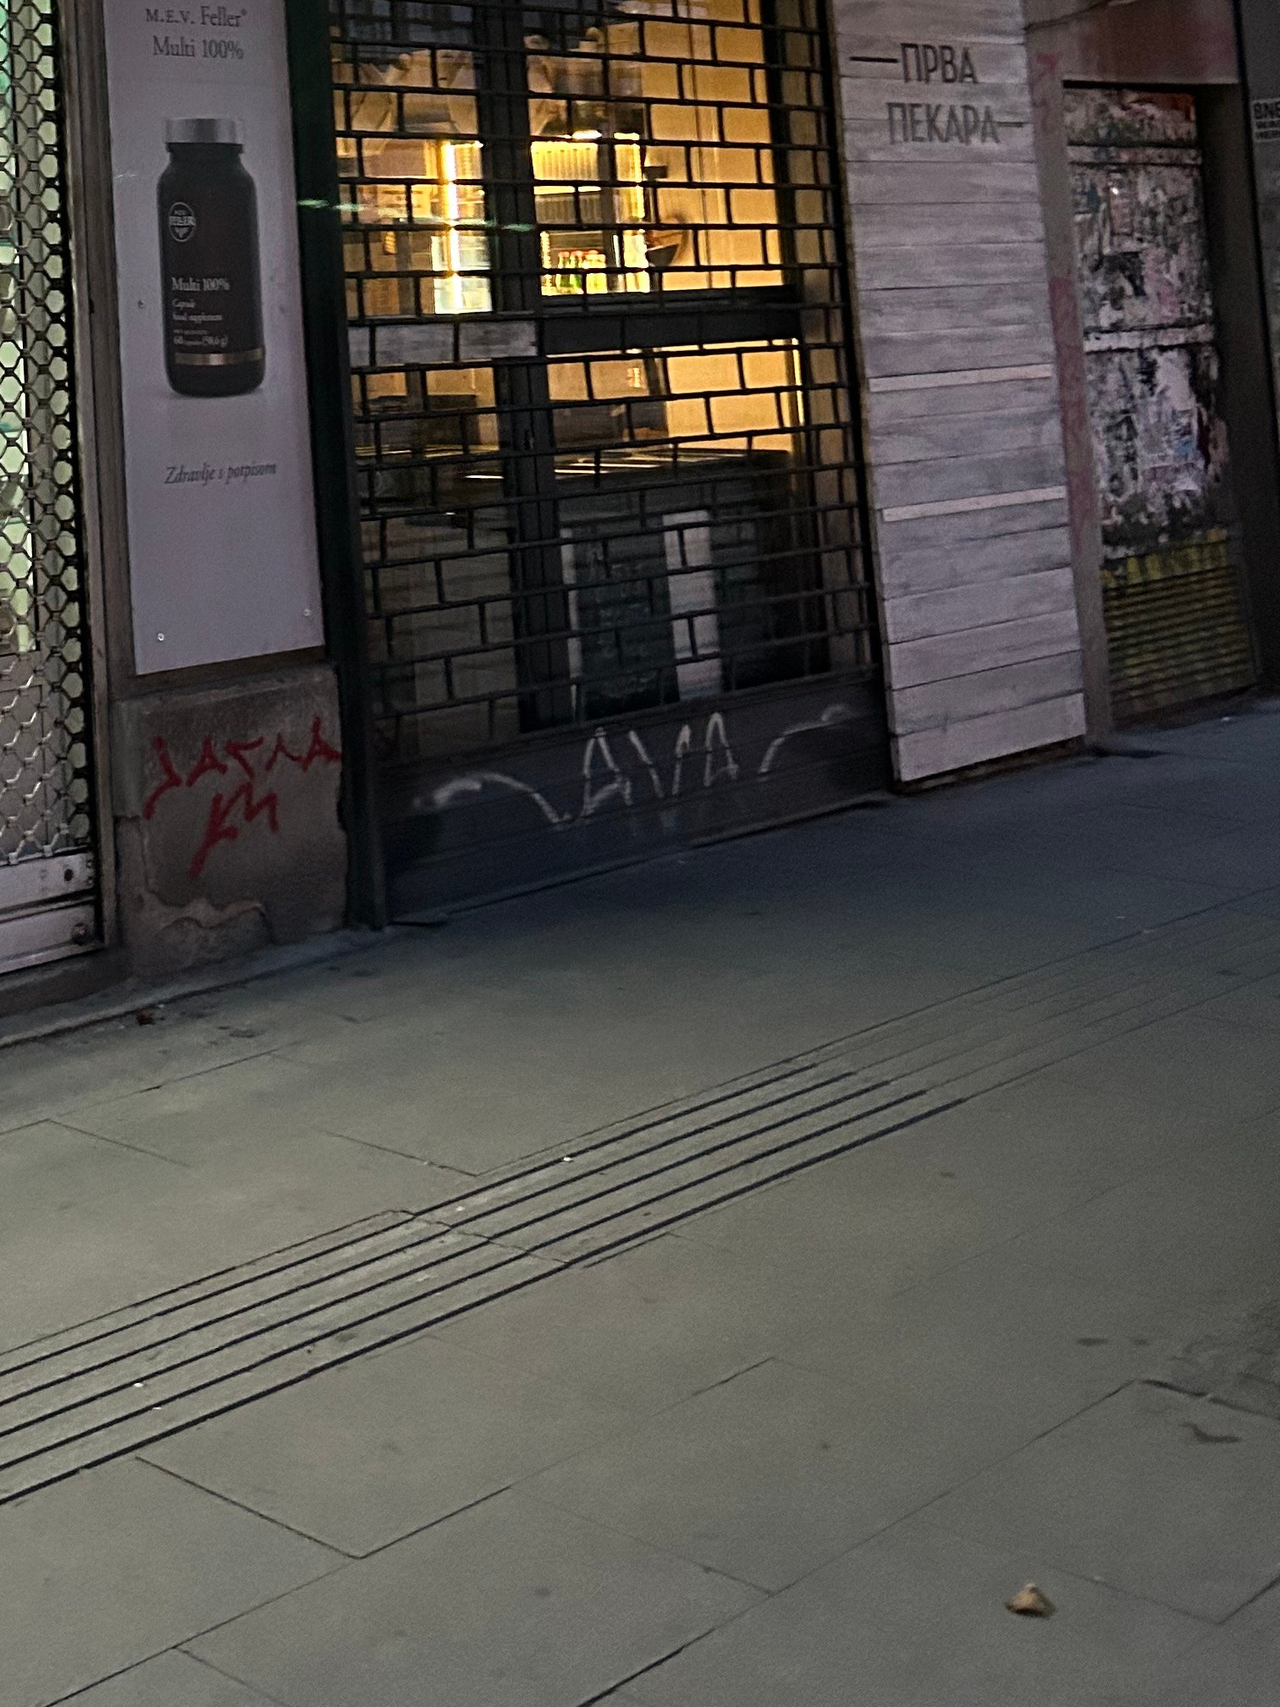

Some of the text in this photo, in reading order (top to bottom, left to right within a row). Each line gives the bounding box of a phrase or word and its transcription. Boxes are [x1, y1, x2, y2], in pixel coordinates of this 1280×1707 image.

[152, 35, 245, 60] Multi 100%
[899, 42, 978, 84] ПРВА
[886, 101, 1001, 145] ПЕКАРА
